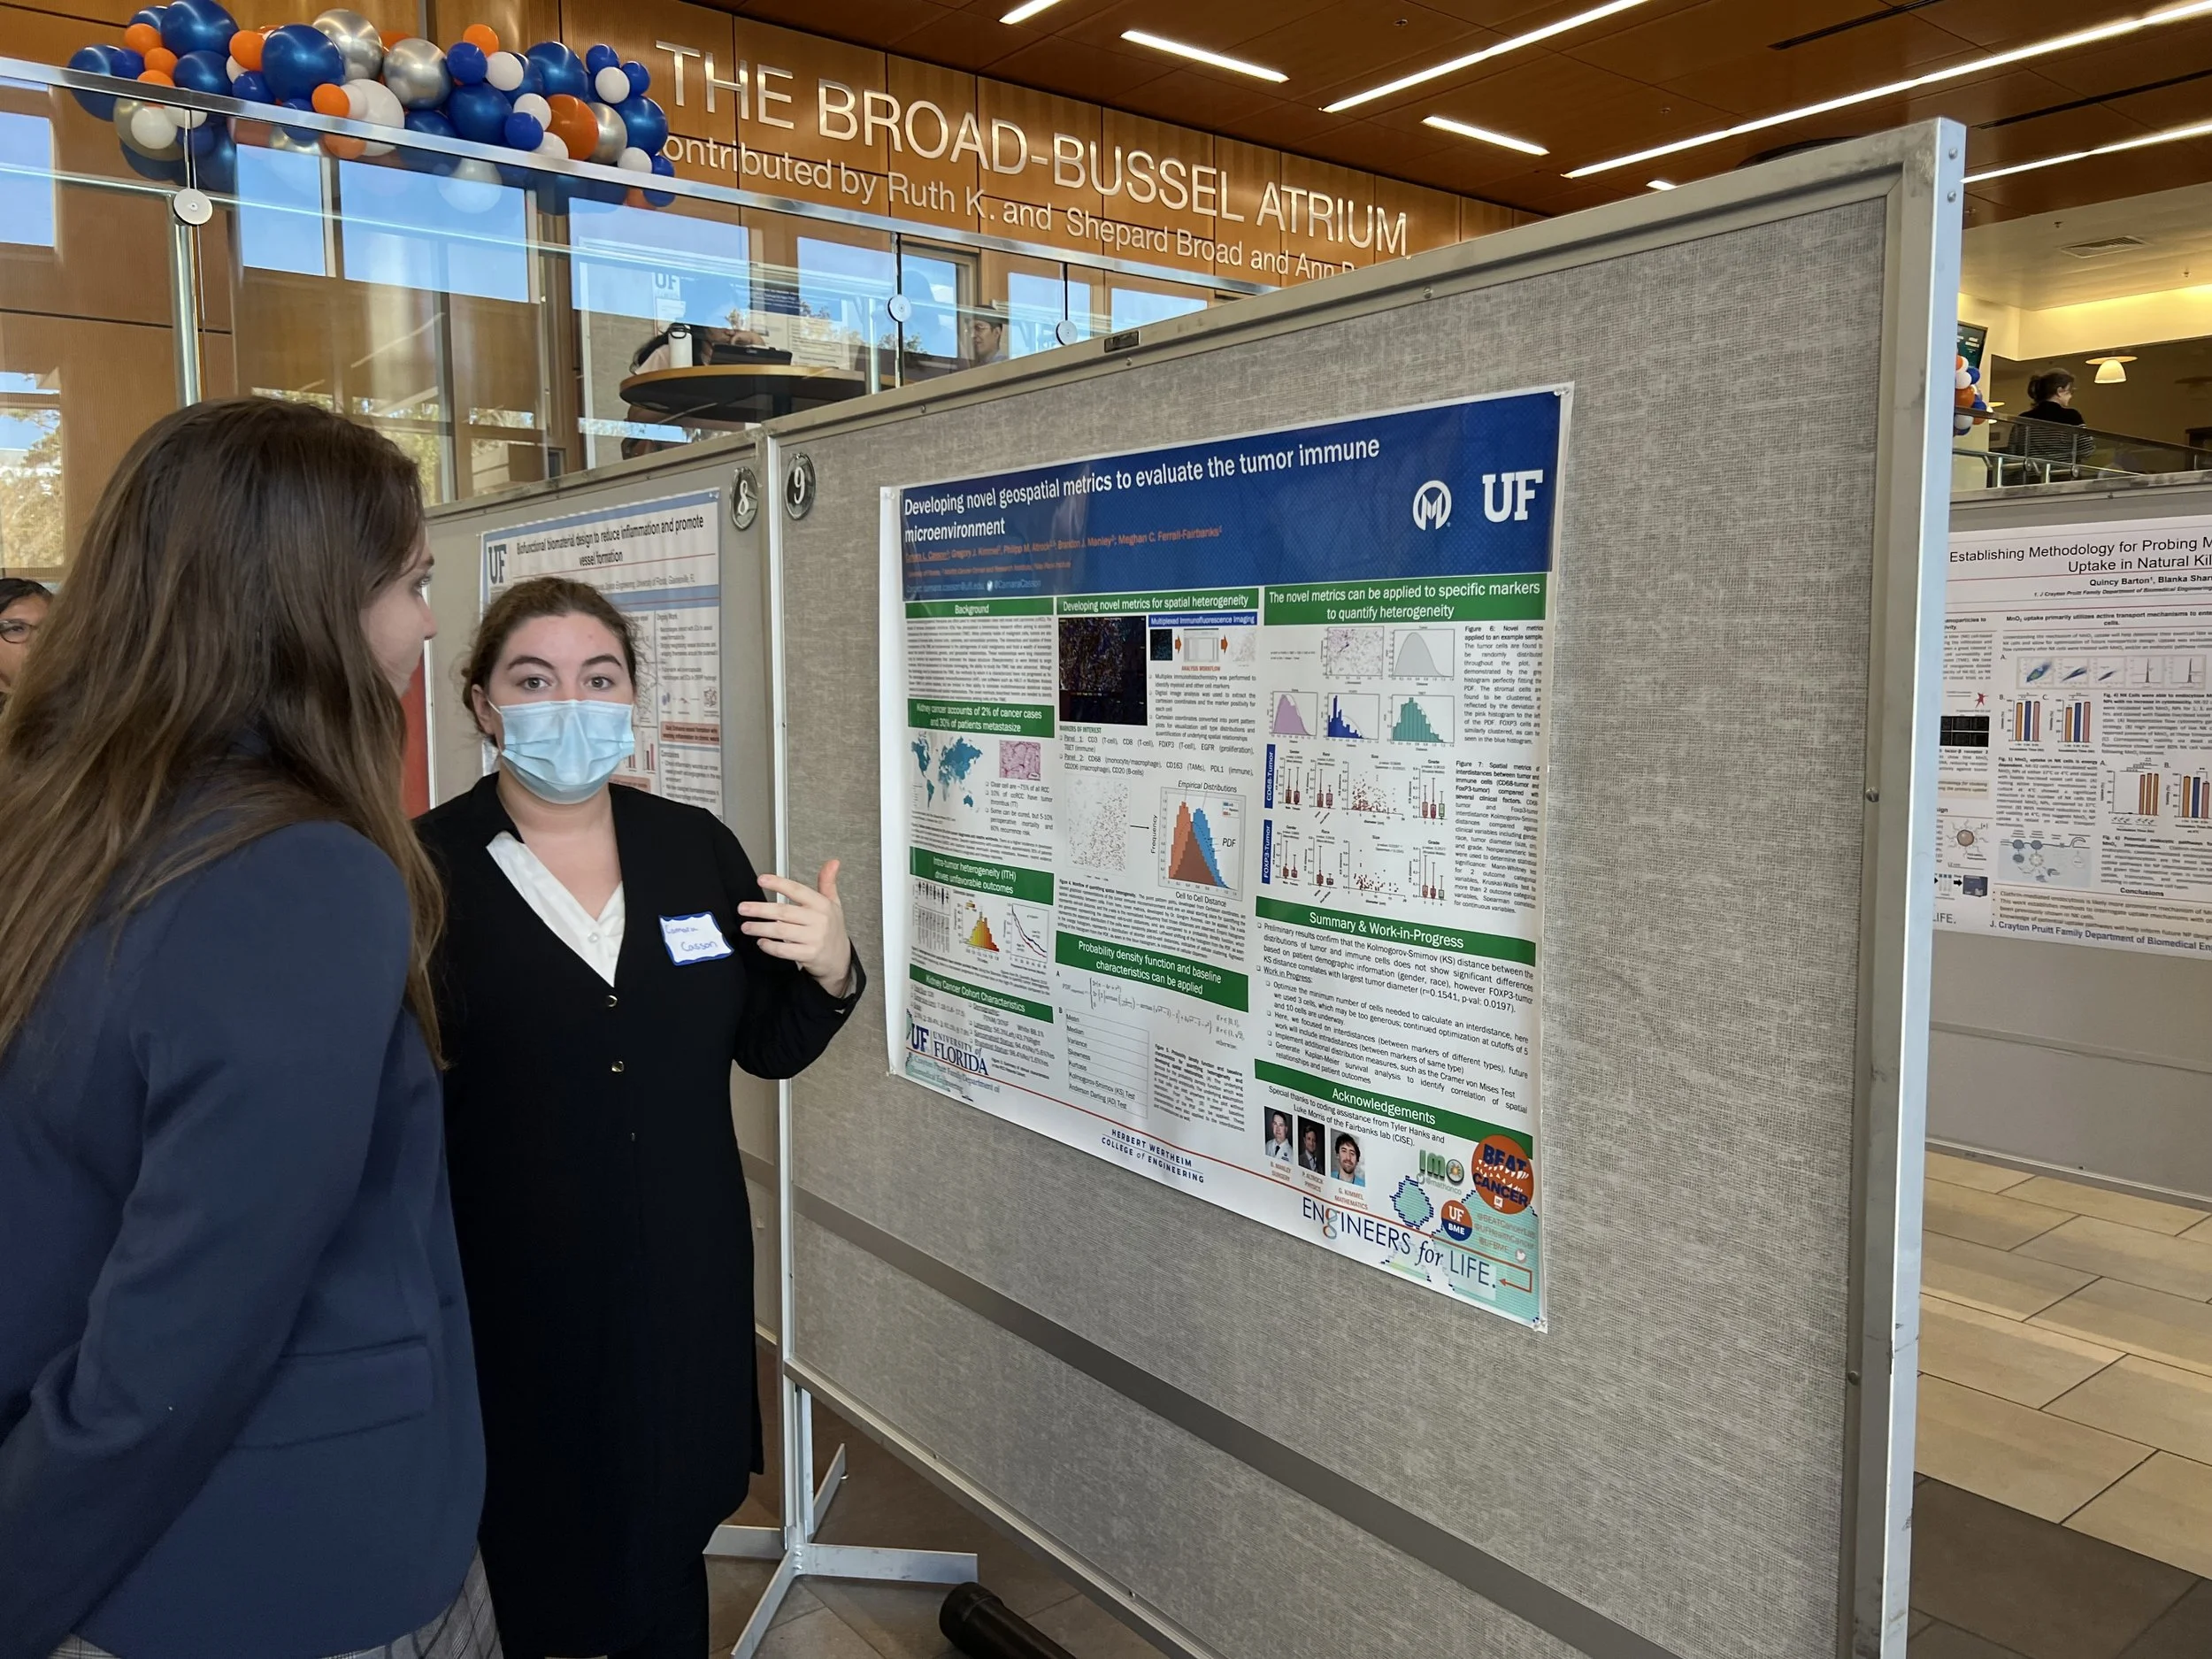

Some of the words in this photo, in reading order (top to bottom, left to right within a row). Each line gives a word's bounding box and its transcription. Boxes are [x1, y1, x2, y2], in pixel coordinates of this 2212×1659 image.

[657, 40, 795, 130] THE
[818, 78, 1245, 222] BROAD-BUSSEL
[1256, 181, 1407, 257] ATRIUM
[663, 134, 833, 190] ontributed
[841, 162, 876, 204] by
[888, 172, 956, 212] Ruth
[965, 185, 995, 220] K.
[1002, 202, 1052, 231] and
[1065, 207, 1168, 252] Shepard
[1176, 227, 1242, 266] Broad
[1250, 249, 1289, 275] and
[793, 466, 805, 505] 9
[904, 494, 964, 516] Developing
[966, 488, 997, 509] novel
[999, 479, 1060, 510] geospatial
[1063, 472, 1112, 496] metrics
[1116, 470, 1132, 489] to
[1135, 463, 1203, 488] evaluate
[1207, 456, 1235, 479] the
[1239, 449, 1294, 474] tumor
[1299, 439, 1380, 466] immune
[737, 480, 749, 516] 8
[1482, 469, 1543, 523] UF
[661, 518, 674, 533] and
[675, 514, 704, 535] promote
[904, 517, 1006, 542] microenvironment
[488, 544, 507, 584] UF
[1949, 549, 2024, 562] Establishing
[2029, 543, 2115, 557] Methodology
[2119, 541, 2138, 553] for
[2142, 538, 2198, 552] Probing
[2068, 559, 2116, 574] Uptake
[2121, 559, 2132, 570] in
[2138, 556, 2189, 569] Natural
[1063, 600, 1098, 613] Developing
[1100, 598, 1121, 610] novel
[1121, 597, 1151, 609] metrics
[1152, 597, 1163, 608] for
[1164, 595, 1191, 611] spatial
[1192, 594, 1249, 609] heterogeneity
[1269, 591, 1285, 603] The
[1286, 590, 1310, 603] novel
[1311, 589, 1346, 602] metrics
[1348, 590, 1365, 601] can
[1367, 588, 1381, 600] be
[1383, 586, 1421, 603] applied
[1424, 585, 1436, 597] to
[1438, 583, 1486, 600] specific
[1489, 581, 1540, 595] markers
[955, 604, 989, 616] Background
[1326, 608, 1338, 620] to
[1338, 606, 1378, 623] quantify
[1379, 604, 1455, 620] heterogeneity
[957, 718, 982, 731] patients
[983, 720, 1021, 733] metastasize
[981, 707, 992, 717] 2%
[993, 707, 1000, 717] of
[1000, 709, 1023, 718] cancer
[1023, 710, 1042, 719] cases
[1203, 782, 1238, 794] Distributions
[1222, 837, 1236, 848] PDF
[1204, 895, 1227, 907] Distance
[2119, 887, 2164, 897] Conclusions
[1310, 911, 1356, 933] Summary
[1358, 920, 1367, 933] &
[1369, 922, 1464, 949] Work-in-Progress
[1999, 921, 2030, 932] Crayton
[2032, 925, 2054, 934] Pruitt
[2055, 926, 2083, 938] Family
[2085, 930, 2134, 943] Department
[2147, 936, 2197, 949] Biomedical
[1078, 940, 1115, 958] Probability
[1116, 949, 1143, 965] density
[1144, 955, 1176, 972] function
[1177, 962, 1191, 974] and
[1192, 965, 1222, 984] baseline
[1263, 922, 1294, 936] Preliminary
[1294, 929, 1316, 940] results
[1316, 933, 1340, 944] confirm
[1340, 938, 1353, 948] that
[1354, 940, 1365, 949] the
[1440, 955, 1455, 966] (KS)
[1456, 958, 1490, 971] distance
[1491, 964, 1524, 977] between
[1524, 970, 1534, 979] the
[1096, 960, 1150, 980] characteristics
[1151, 972, 1165, 983] can
[1166, 975, 1176, 987] be
[1177, 978, 1203, 995] applied
[911, 1023, 929, 1052] UF
[933, 1031, 972, 1053] UNIVERSITY
[974, 1047, 983, 1057] of
[933, 1041, 989, 1076] FLORIDA
[1268, 1086, 1290, 1099] Special
[1290, 1092, 1309, 1105] thanks
[1310, 1098, 1317, 1108] to
[1316, 1101, 1336, 1116] coding
[1336, 1108, 1371, 1124] assistance
[1372, 1117, 1389, 1128] from
[1391, 1121, 1408, 1133] Tyler
[1409, 1126, 1431, 1140] Hanks
[1432, 1133, 1445, 1144] and
[1332, 1087, 1436, 1125] Acknowledgements
[1294, 1104, 1307, 1115] Luke
[1308, 1110, 1325, 1121] Morris
[1326, 1115, 1333, 1124] of
[1333, 1118, 1344, 1127] the
[1345, 1121, 1379, 1137] Fairbanks
[1379, 1130, 1391, 1140] lab
[1392, 1133, 1415, 1148] (CISE).
[1102, 1137, 1133, 1156] COLLEGE
[1136, 1149, 1145, 1160] of
[1148, 1156, 1204, 1184] ENGINEERING
[1111, 1129, 1147, 1149] HERBERT
[1149, 1141, 1193, 1167] WERTHEIM
[1483, 1143, 1527, 1172] BEAT
[1472, 1172, 1531, 1208] CANCER
[1448, 1205, 1464, 1222] UF
[1448, 1223, 1465, 1235] BME
[1415, 1240, 1444, 1266] for
[1449, 1249, 1496, 1289] LIFE.
